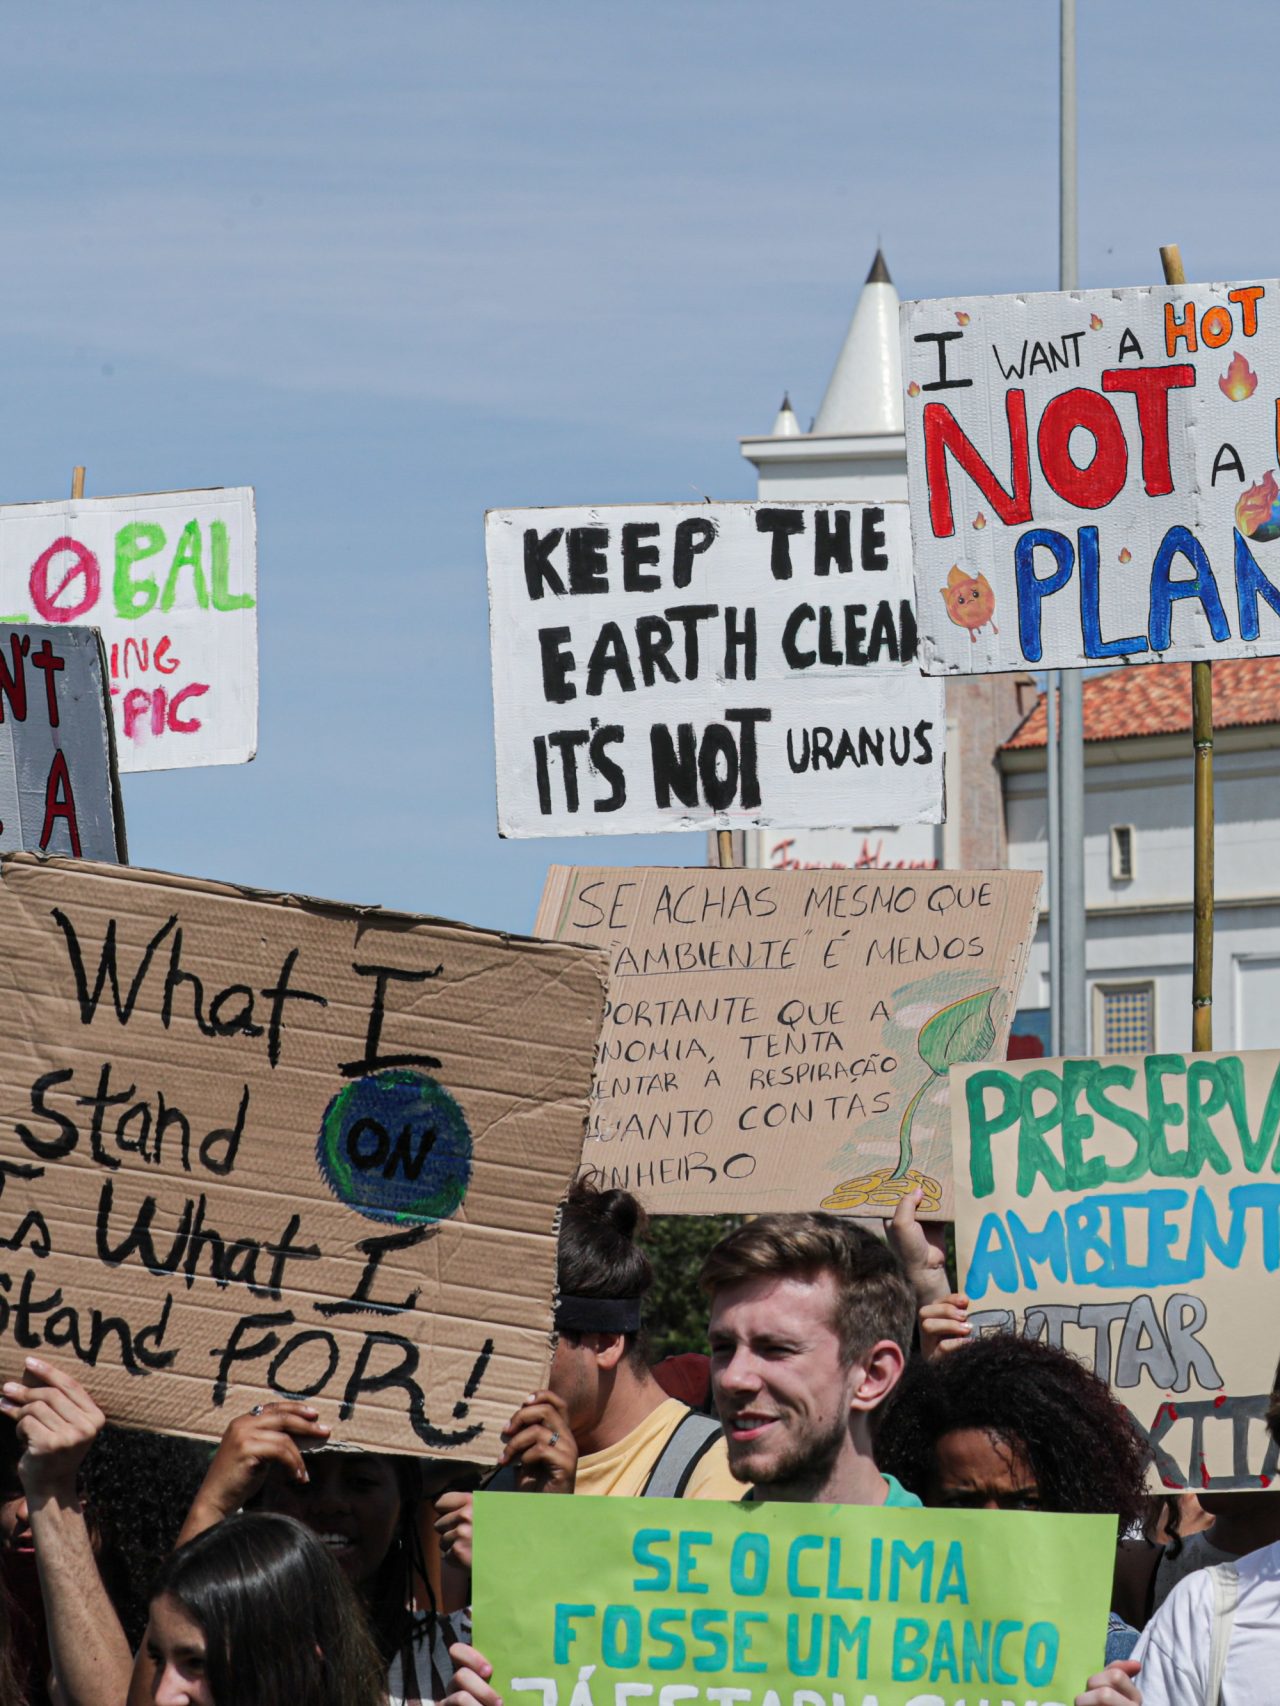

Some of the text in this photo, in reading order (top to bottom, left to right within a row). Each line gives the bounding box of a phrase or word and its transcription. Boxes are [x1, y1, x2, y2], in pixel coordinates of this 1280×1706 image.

[915, 331, 973, 391] I
[992, 332, 1086, 380] WANT
[1118, 328, 1144, 363] A
[1163, 286, 1265, 357] HOT
[923, 364, 1196, 538] NOT
[1211, 443, 1245, 487] A
[0, 517, 256, 623] OBAL
[523, 507, 888, 600] KEEP THE
[538, 603, 757, 704] EARTH
[39, 749, 82, 858] A
[533, 708, 934, 815] IT'S NOT URANUS
[572, 882, 992, 929] SE ACHAS MESMO QUE
[823, 929, 851, 969] É
[866, 934, 984, 967] MENOS
[51, 907, 444, 1078] What I
[777, 999, 845, 1032] QUE
[870, 1000, 890, 1021] A
[740, 1031, 844, 1060] TENTA
[750, 1053, 898, 1089] RESPIRAÇÃO
[14, 1063, 437, 1180] Stand ON
[739, 1092, 890, 1131] CONTAS
[96, 1177, 320, 1300] What
[313, 1225, 441, 1318] I
[966, 1293, 1224, 1393] TAR
[632, 1528, 970, 1605] SE O CLIMA
[553, 1603, 1060, 1687] FOSSE UM BANCO
